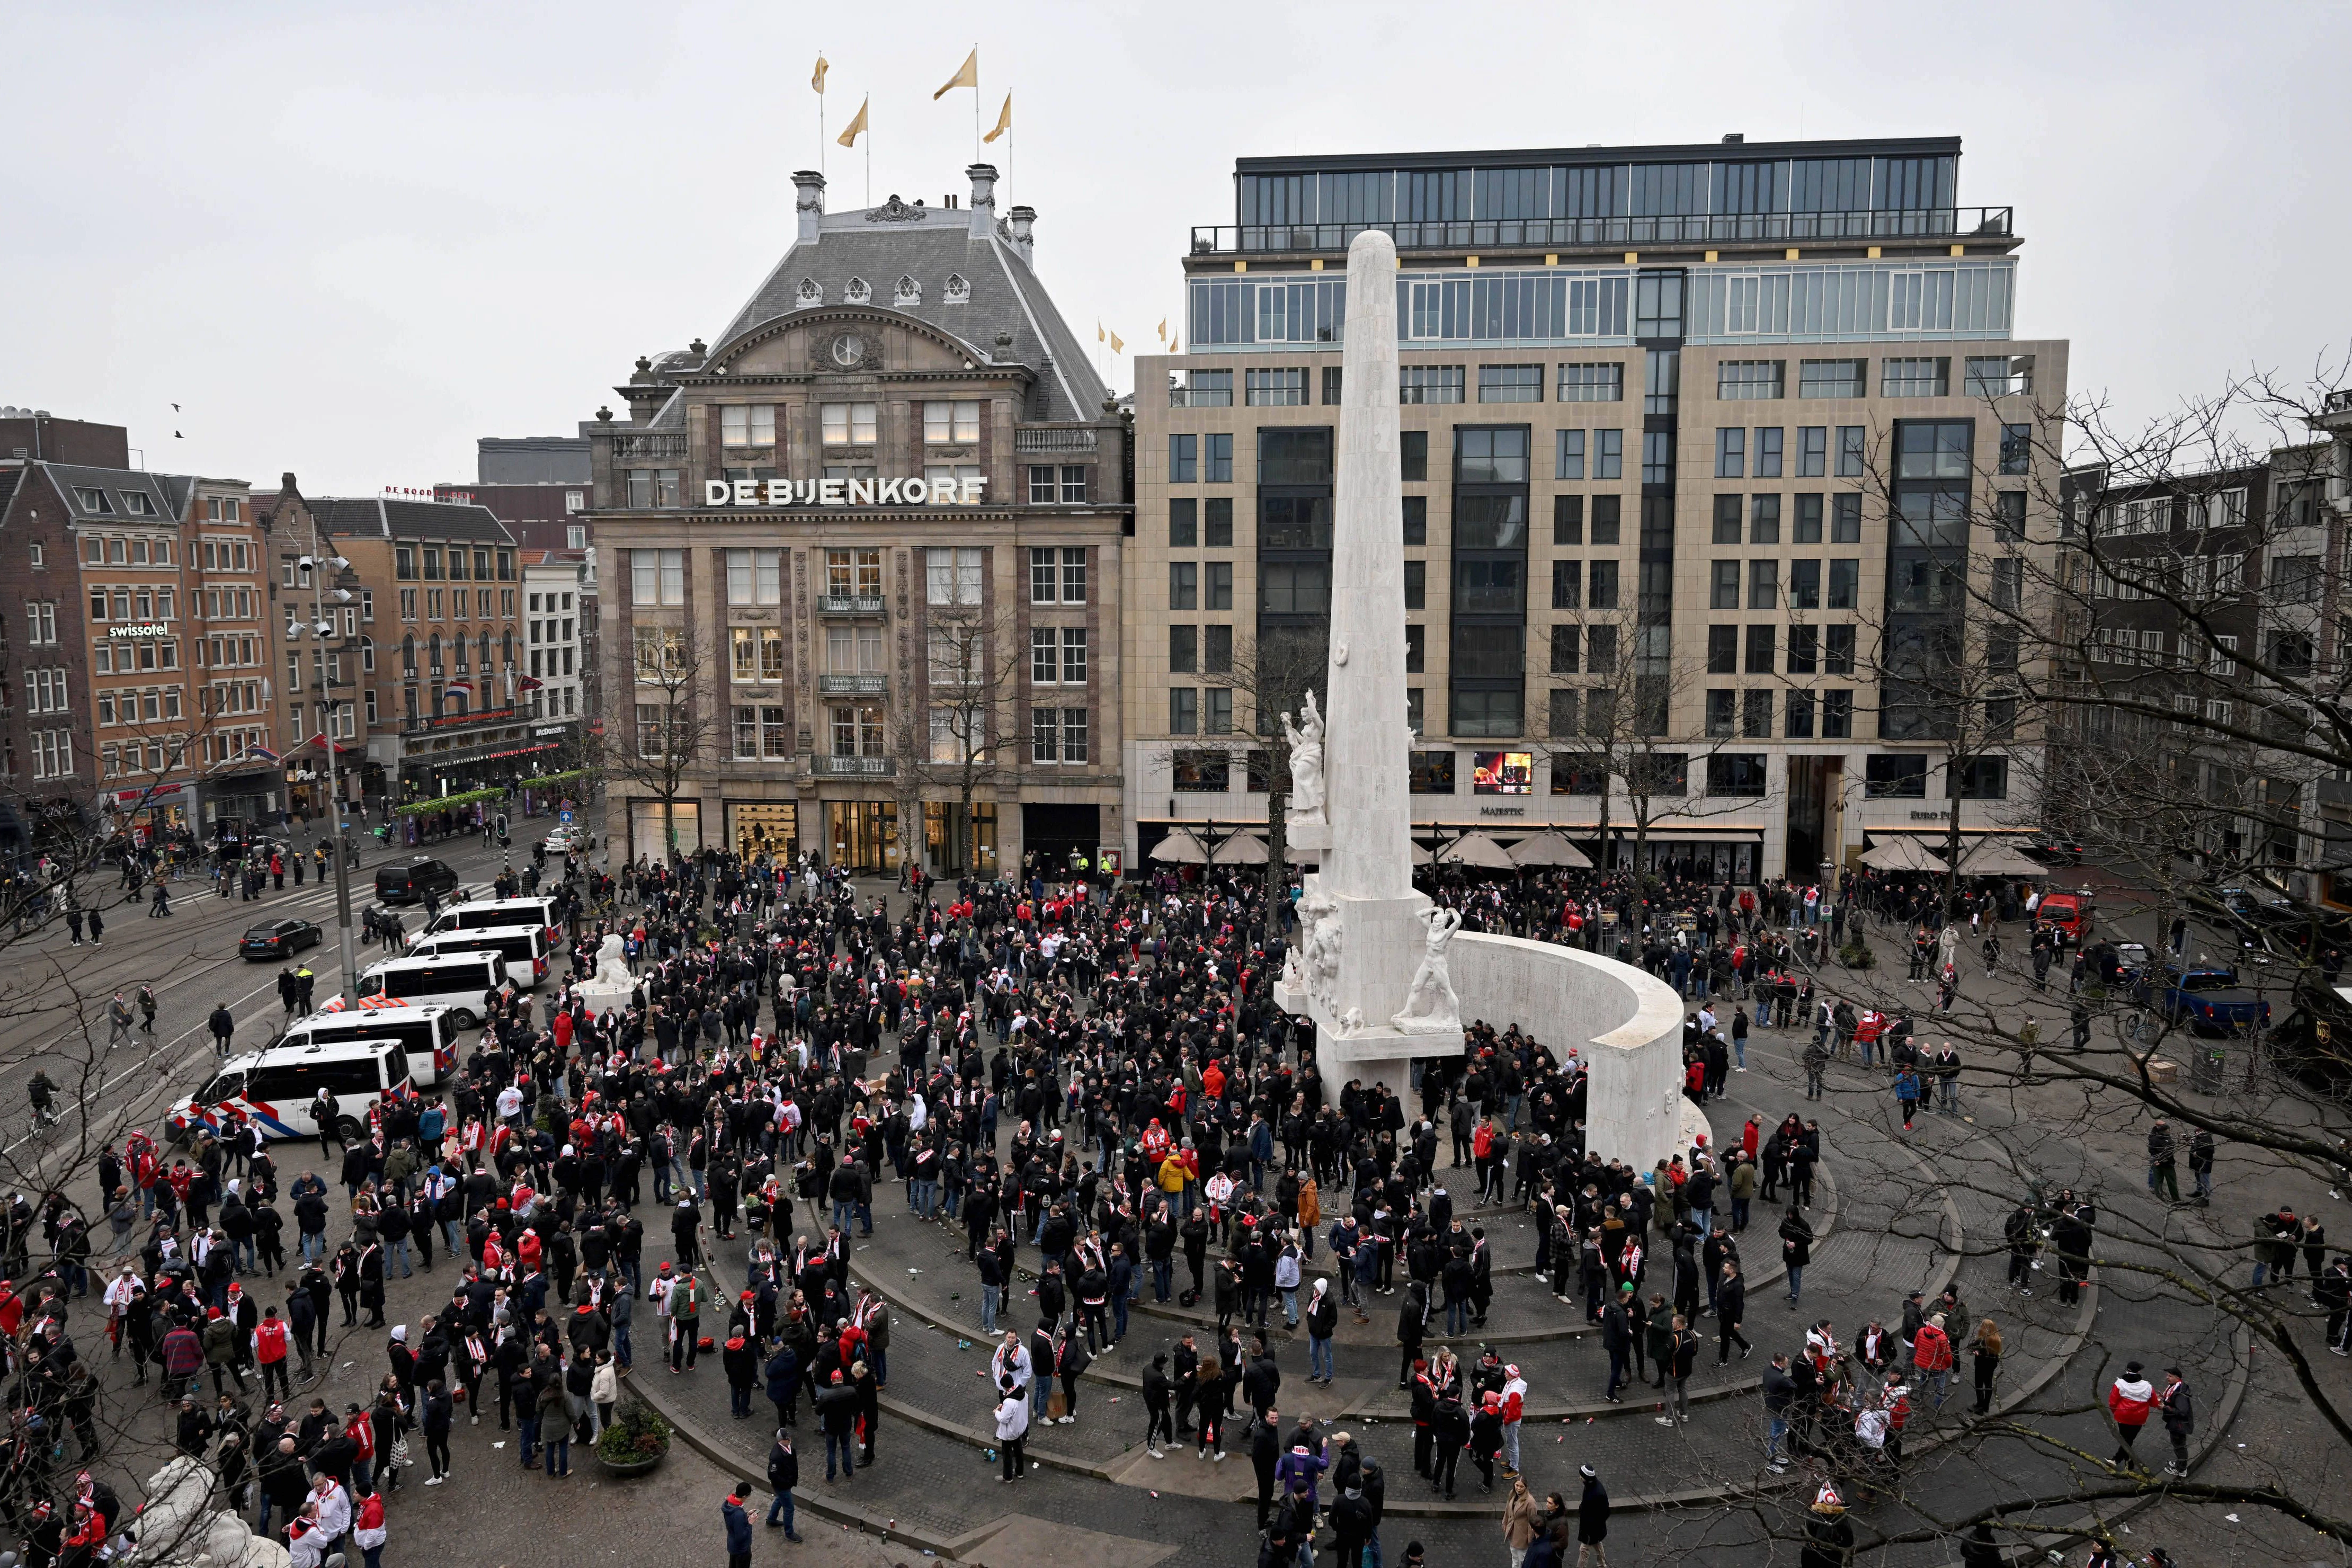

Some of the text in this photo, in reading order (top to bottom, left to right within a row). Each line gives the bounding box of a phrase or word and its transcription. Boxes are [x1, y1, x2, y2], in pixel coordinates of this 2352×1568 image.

[404, 487, 439, 496] ROODE
[706, 477, 987, 506] DE BIJENKORF
[453, 755, 484, 764] AMSTERDAM
[1480, 806, 1524, 816] MAJESTIC
[1910, 810, 1952, 819] EURO PU
